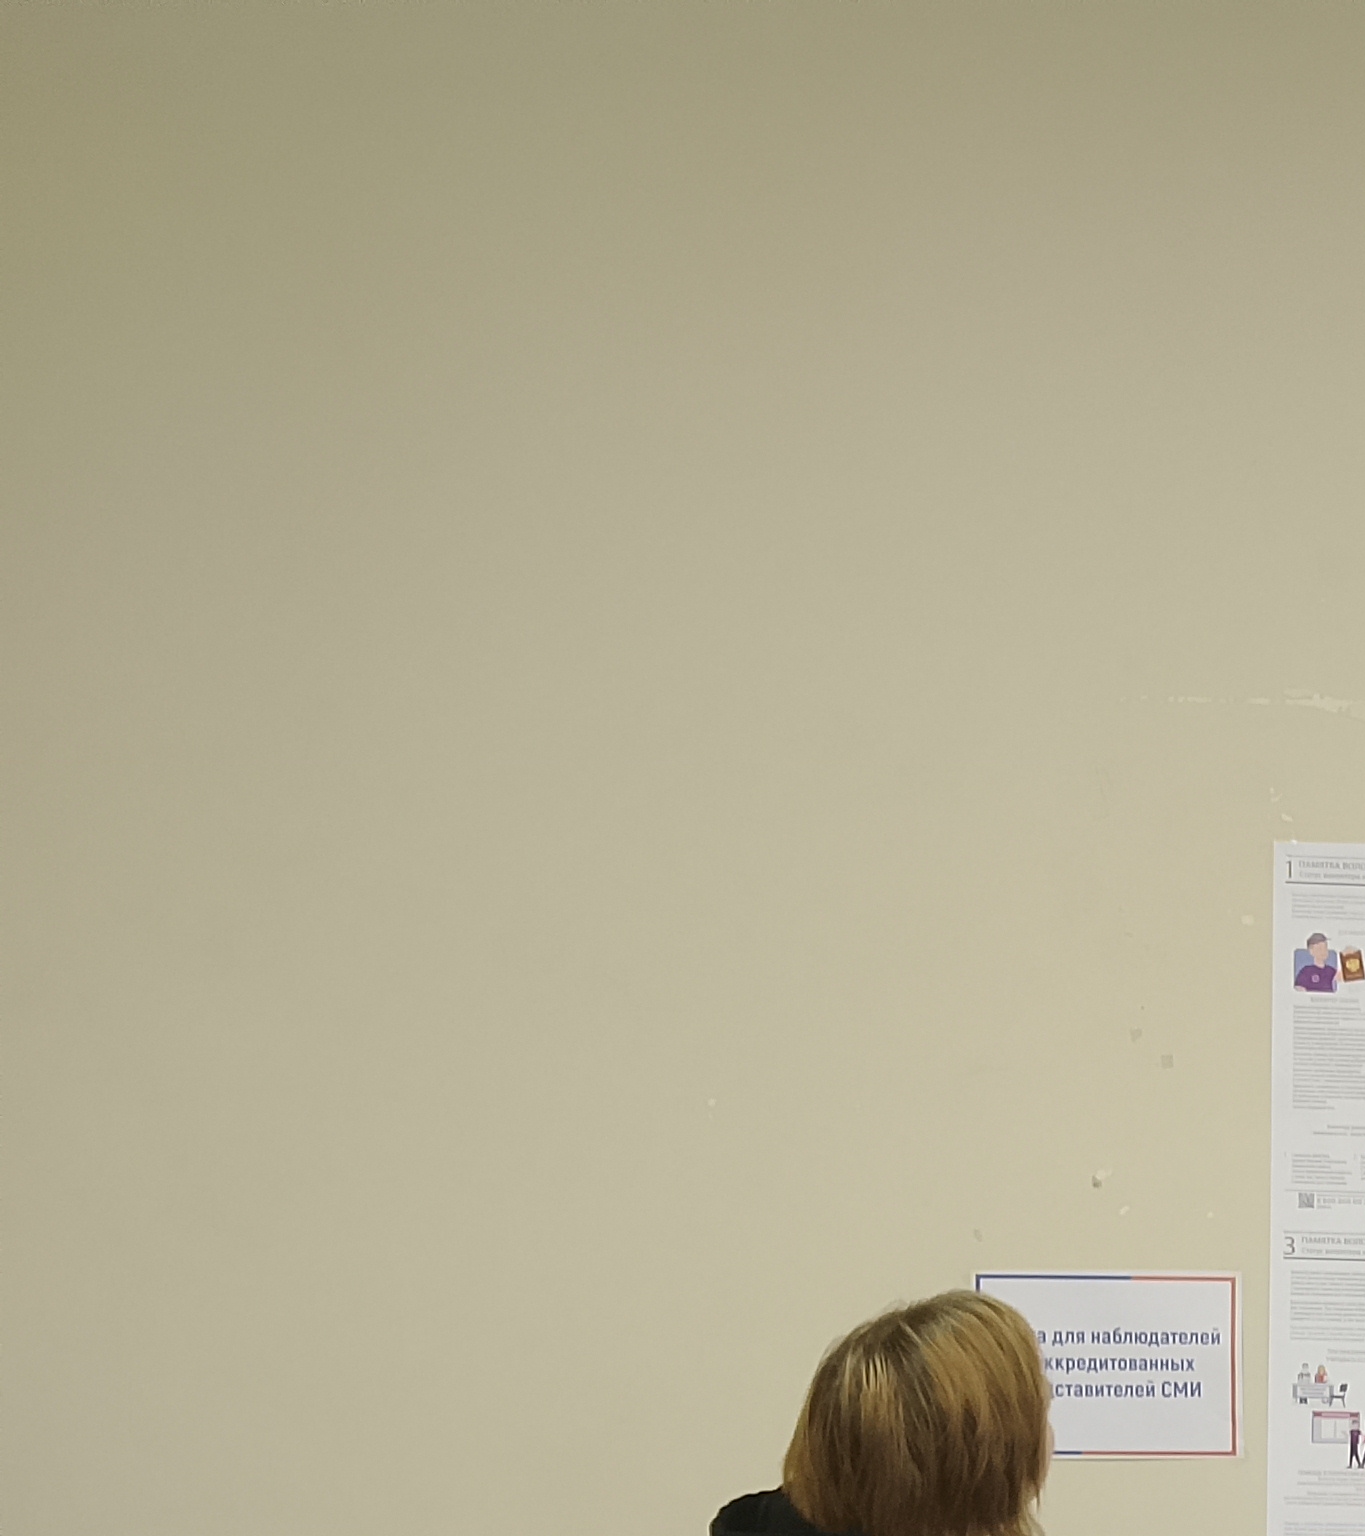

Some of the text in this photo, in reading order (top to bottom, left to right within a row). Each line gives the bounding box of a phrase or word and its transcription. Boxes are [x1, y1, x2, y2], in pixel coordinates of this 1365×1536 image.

[1286, 860, 1292, 878] 1
[1284, 1236, 1295, 1255] 3
[1052, 1330, 1085, 1346] для
[1091, 1327, 1221, 1347] наблюдателей
[1044, 1357, 1195, 1375] ккредитованных
[1051, 1380, 1202, 1398] ставителей СМИ
